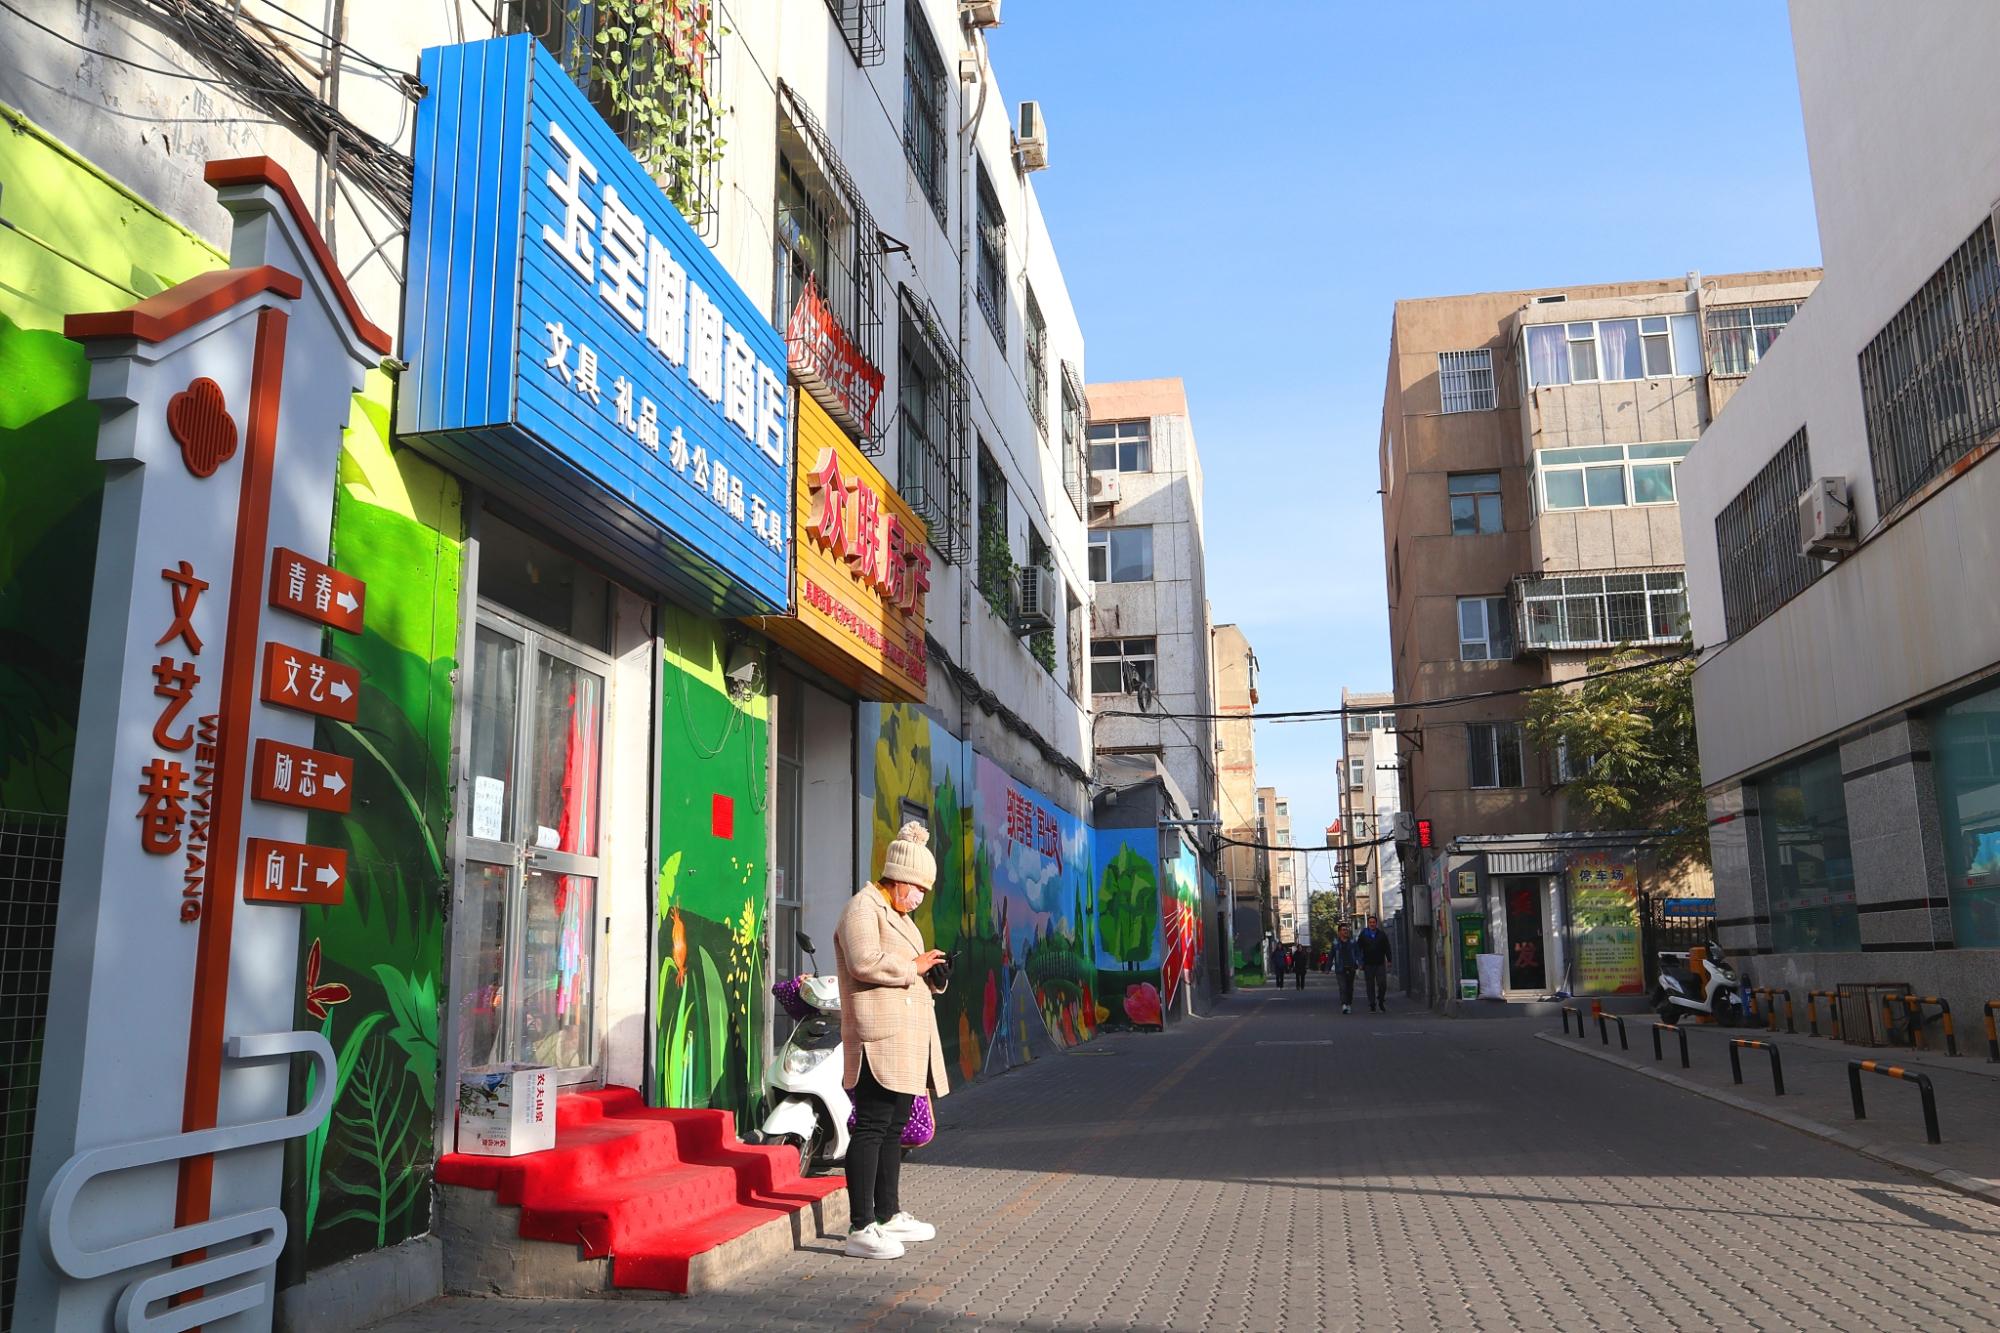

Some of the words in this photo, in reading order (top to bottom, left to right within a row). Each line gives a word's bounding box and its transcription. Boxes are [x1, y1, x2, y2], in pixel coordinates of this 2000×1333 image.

[545, 321, 600, 405] 文具
[613, 375, 660, 453] 礼品
[669, 425, 745, 523] 办公用品
[750, 493, 782, 553] 玩具
[807, 447, 931, 615] 众联房产
[288, 562, 331, 613] 青春
[283, 656, 325, 702] 文艺
[136, 560, 209, 854] 文艺巷
[274, 752, 317, 797] 励志
[180, 714, 219, 923] WENYIXIANG
[265, 849, 308, 893] 向上
[1580, 869, 1624, 881] 停车场
